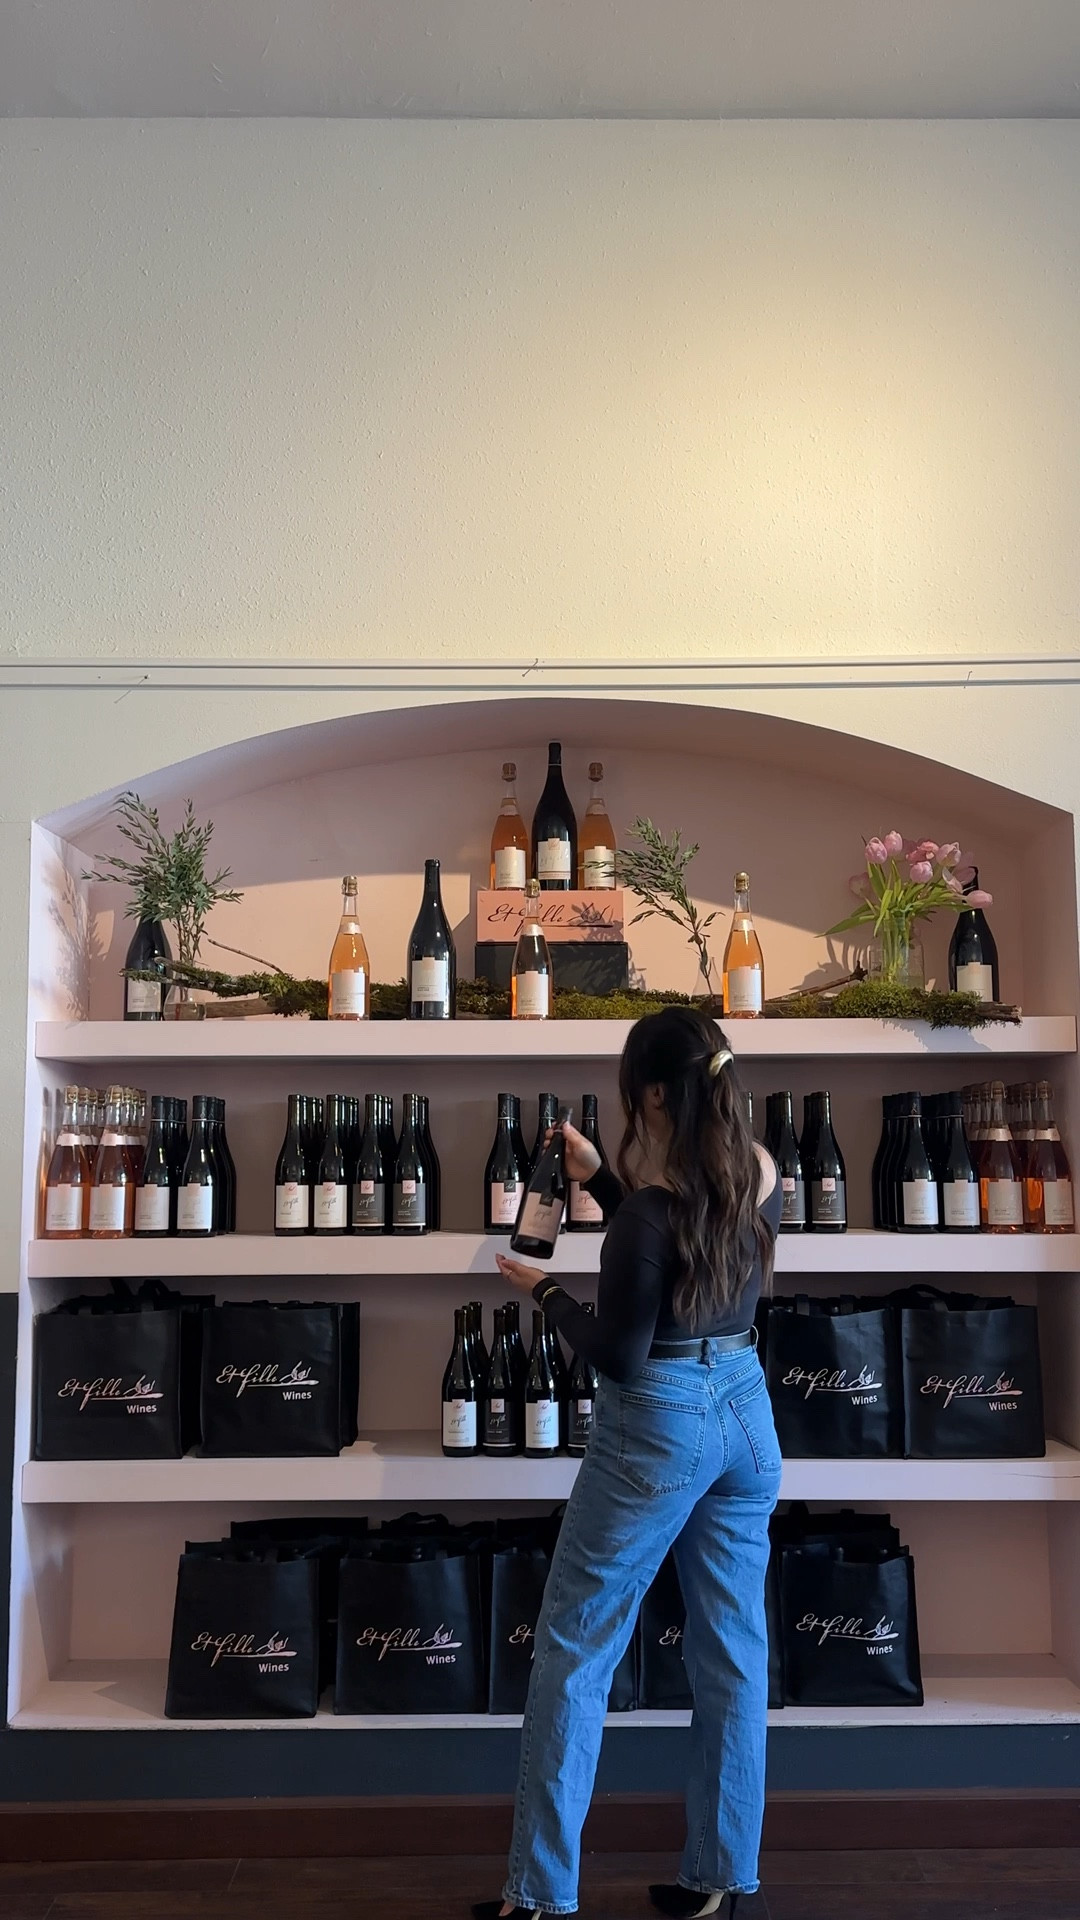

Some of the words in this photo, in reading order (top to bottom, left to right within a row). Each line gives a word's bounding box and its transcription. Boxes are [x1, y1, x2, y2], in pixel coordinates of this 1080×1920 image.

[488, 904, 514, 922] Et
[216, 1365, 240, 1384] Et
[782, 1367, 807, 1385] Et
[58, 1379, 82, 1397] Et
[920, 1376, 945, 1394] Et
[282, 1391, 312, 1400] Wines
[851, 1395, 878, 1405] Wines
[126, 1404, 157, 1414] Wines
[988, 1401, 1017, 1411] Wines
[796, 1613, 821, 1631] Et
[191, 1632, 215, 1651] Et
[356, 1627, 381, 1646] Et
[509, 1624, 534, 1644] Et
[659, 1626, 684, 1645] Et
[426, 1654, 456, 1664] Wines
[866, 1645, 893, 1655] Wines
[258, 1663, 289, 1673] Wines
